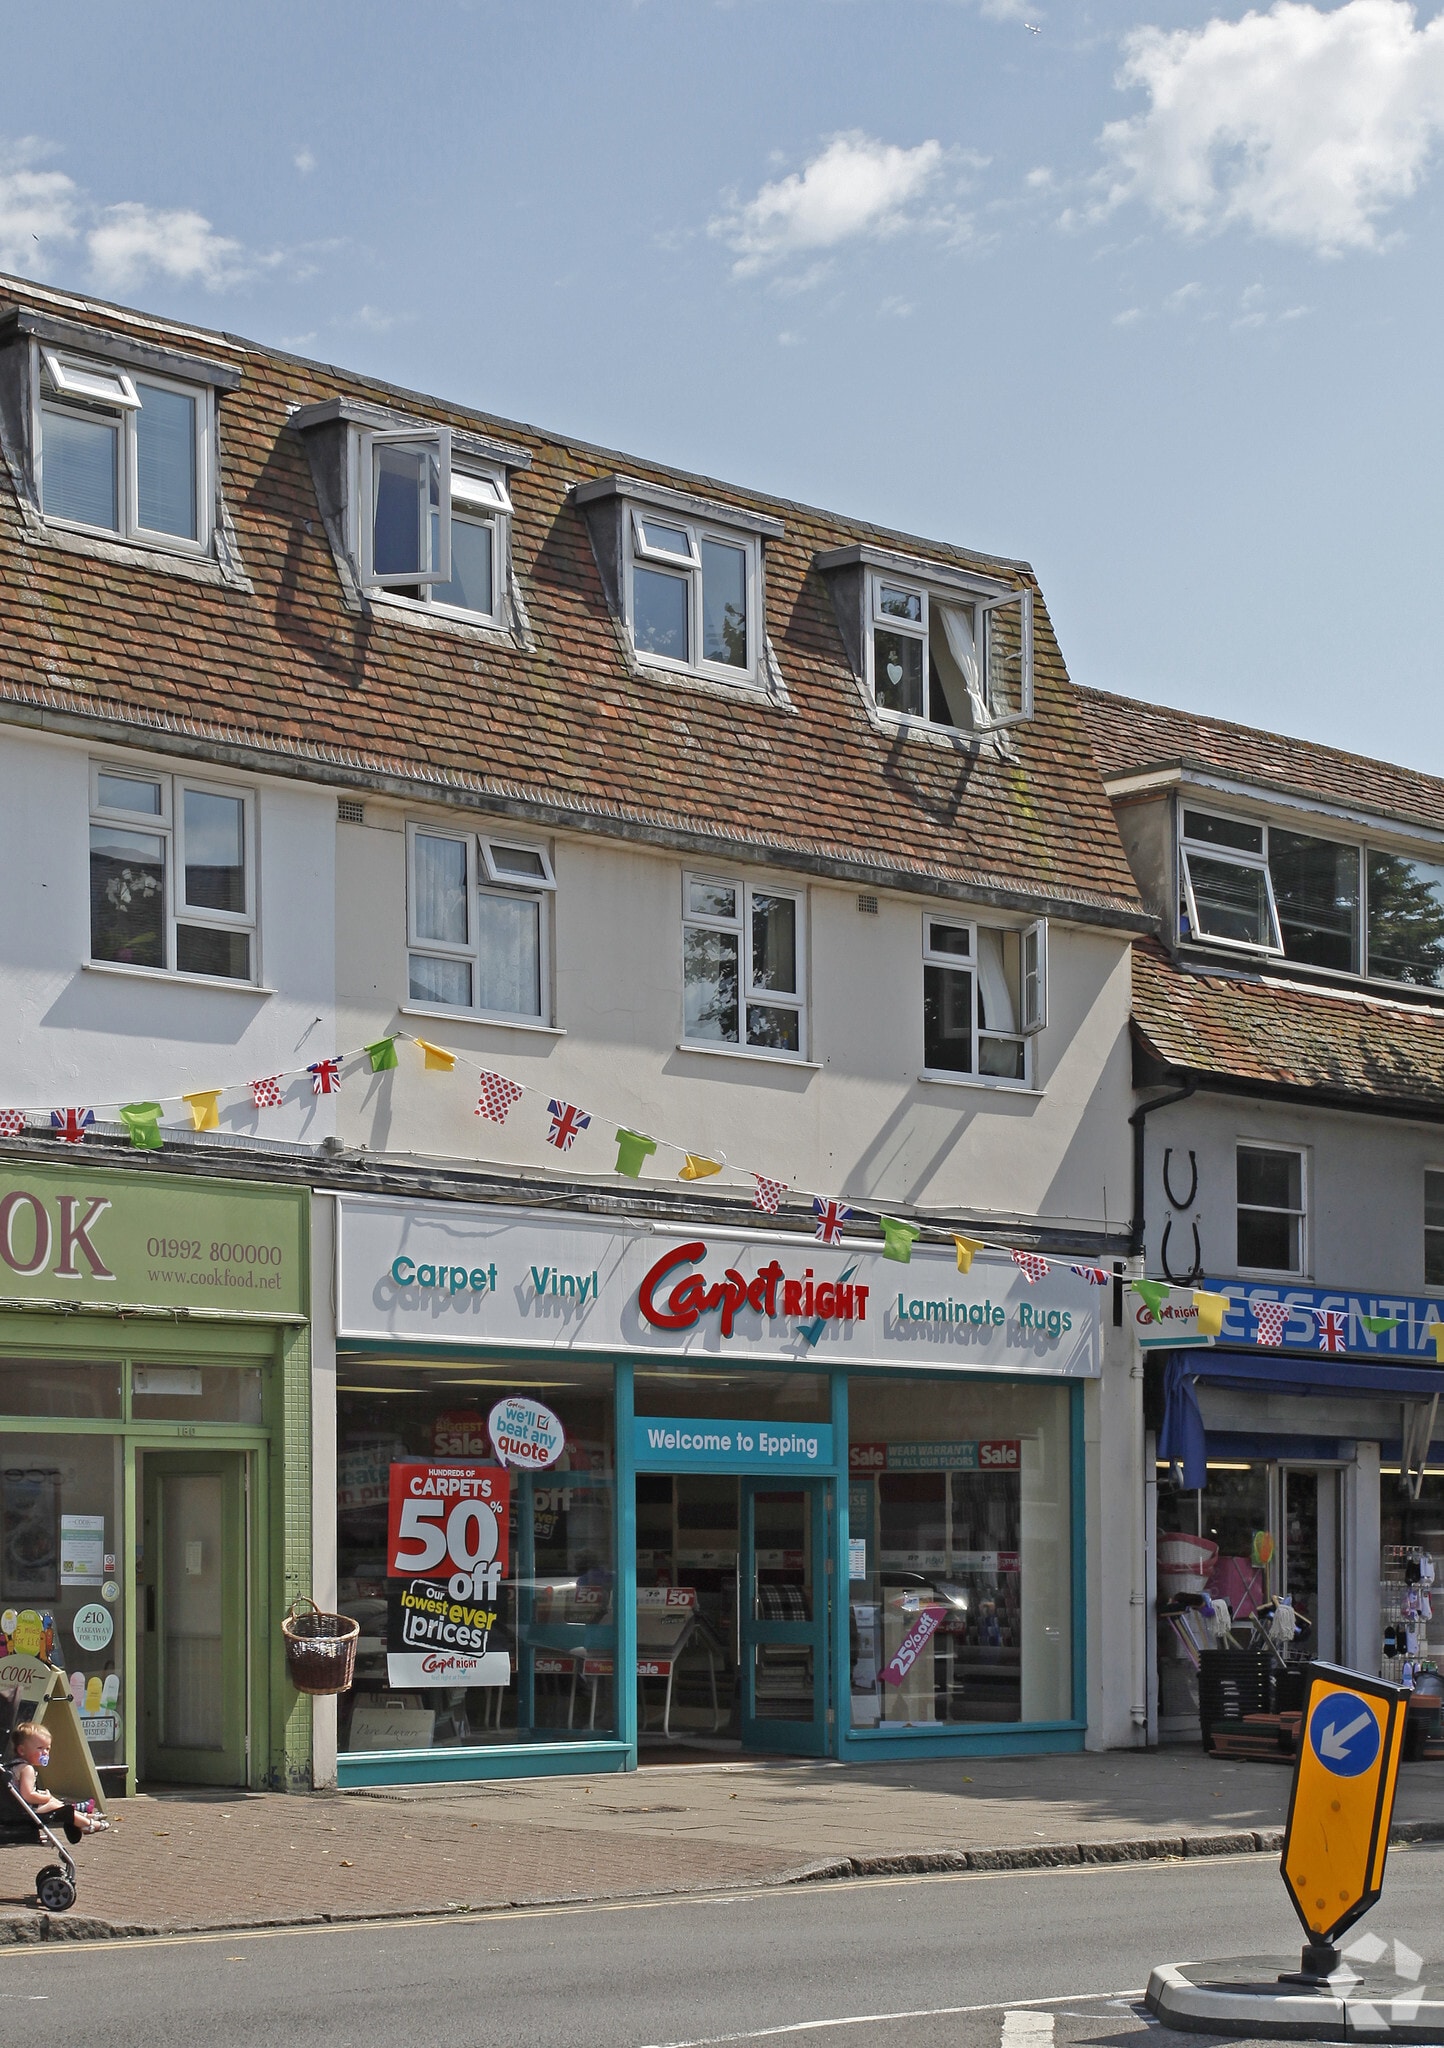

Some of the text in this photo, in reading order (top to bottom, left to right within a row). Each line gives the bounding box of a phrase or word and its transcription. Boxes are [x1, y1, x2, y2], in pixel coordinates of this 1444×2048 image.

[146, 1237, 282, 1265] 01992 800000
[148, 1268, 282, 1290] www.cookfood.net
[392, 1256, 599, 1303] Carpet Vinyl
[898, 1293, 1073, 1338] Laminate Rugs
[435, 1422, 484, 1433] BIGGEST
[506, 1407, 536, 1427] we'll
[497, 1415, 529, 1440] beat
[530, 1429, 557, 1450] any
[434, 1432, 484, 1456] Sale
[498, 1435, 549, 1463] quote
[647, 1429, 818, 1458] Welcome to Epping
[918, 1444, 975, 1457] WARRANTY
[850, 1447, 884, 1467] Sale
[903, 1457, 918, 1467] ALL
[920, 1457, 938, 1466] OUR
[940, 1456, 974, 1466] FLOORS
[981, 1444, 1018, 1465] Sale
[428, 1468, 476, 1478] HUNDREDS OF
[410, 1477, 492, 1498] CARPETS
[448, 1560, 503, 1601] off
[426, 1587, 446, 1600] Our
[82, 1611, 104, 1624] £10
[401, 1590, 497, 1631] lowest ever
[76, 1626, 110, 1634] TAKEAWAY
[410, 1613, 483, 1649] prices
[890, 1612, 933, 1677] 25% off
[1, 1665, 36, 1683] COOK
[535, 1660, 563, 1672] Sale
